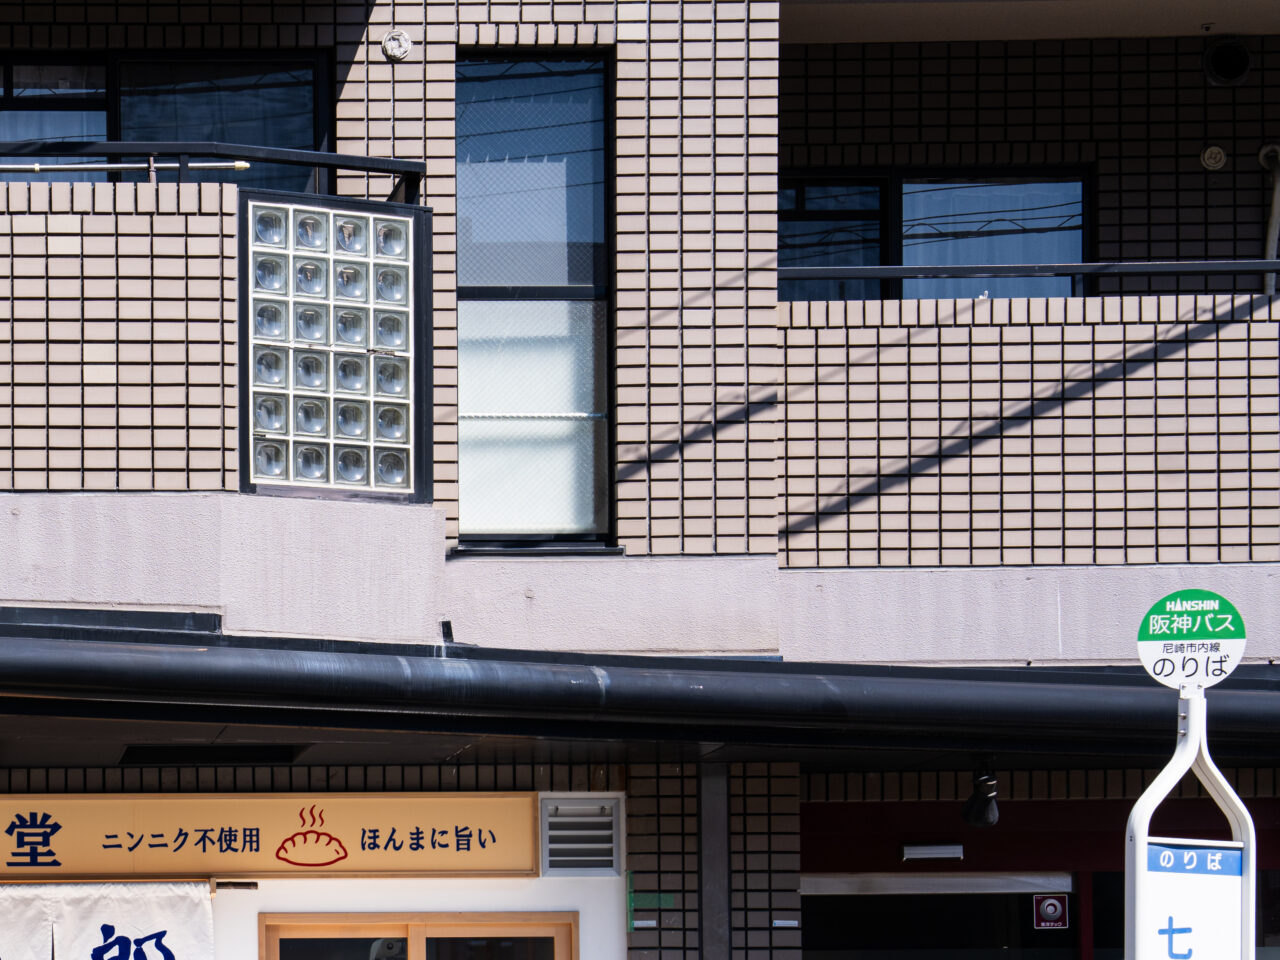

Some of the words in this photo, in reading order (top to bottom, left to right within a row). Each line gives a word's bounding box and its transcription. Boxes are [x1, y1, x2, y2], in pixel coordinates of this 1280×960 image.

[1166, 598, 1219, 611] HANSHIN
[1149, 614, 1235, 635] 阪神バス
[1163, 642, 1220, 653] 尼崎市内線
[1153, 654, 1229, 678] のりば
[102, 827, 261, 854] ニンニク不使用
[360, 827, 497, 852] ほんまに旨い
[1159, 849, 1223, 870] のりば
